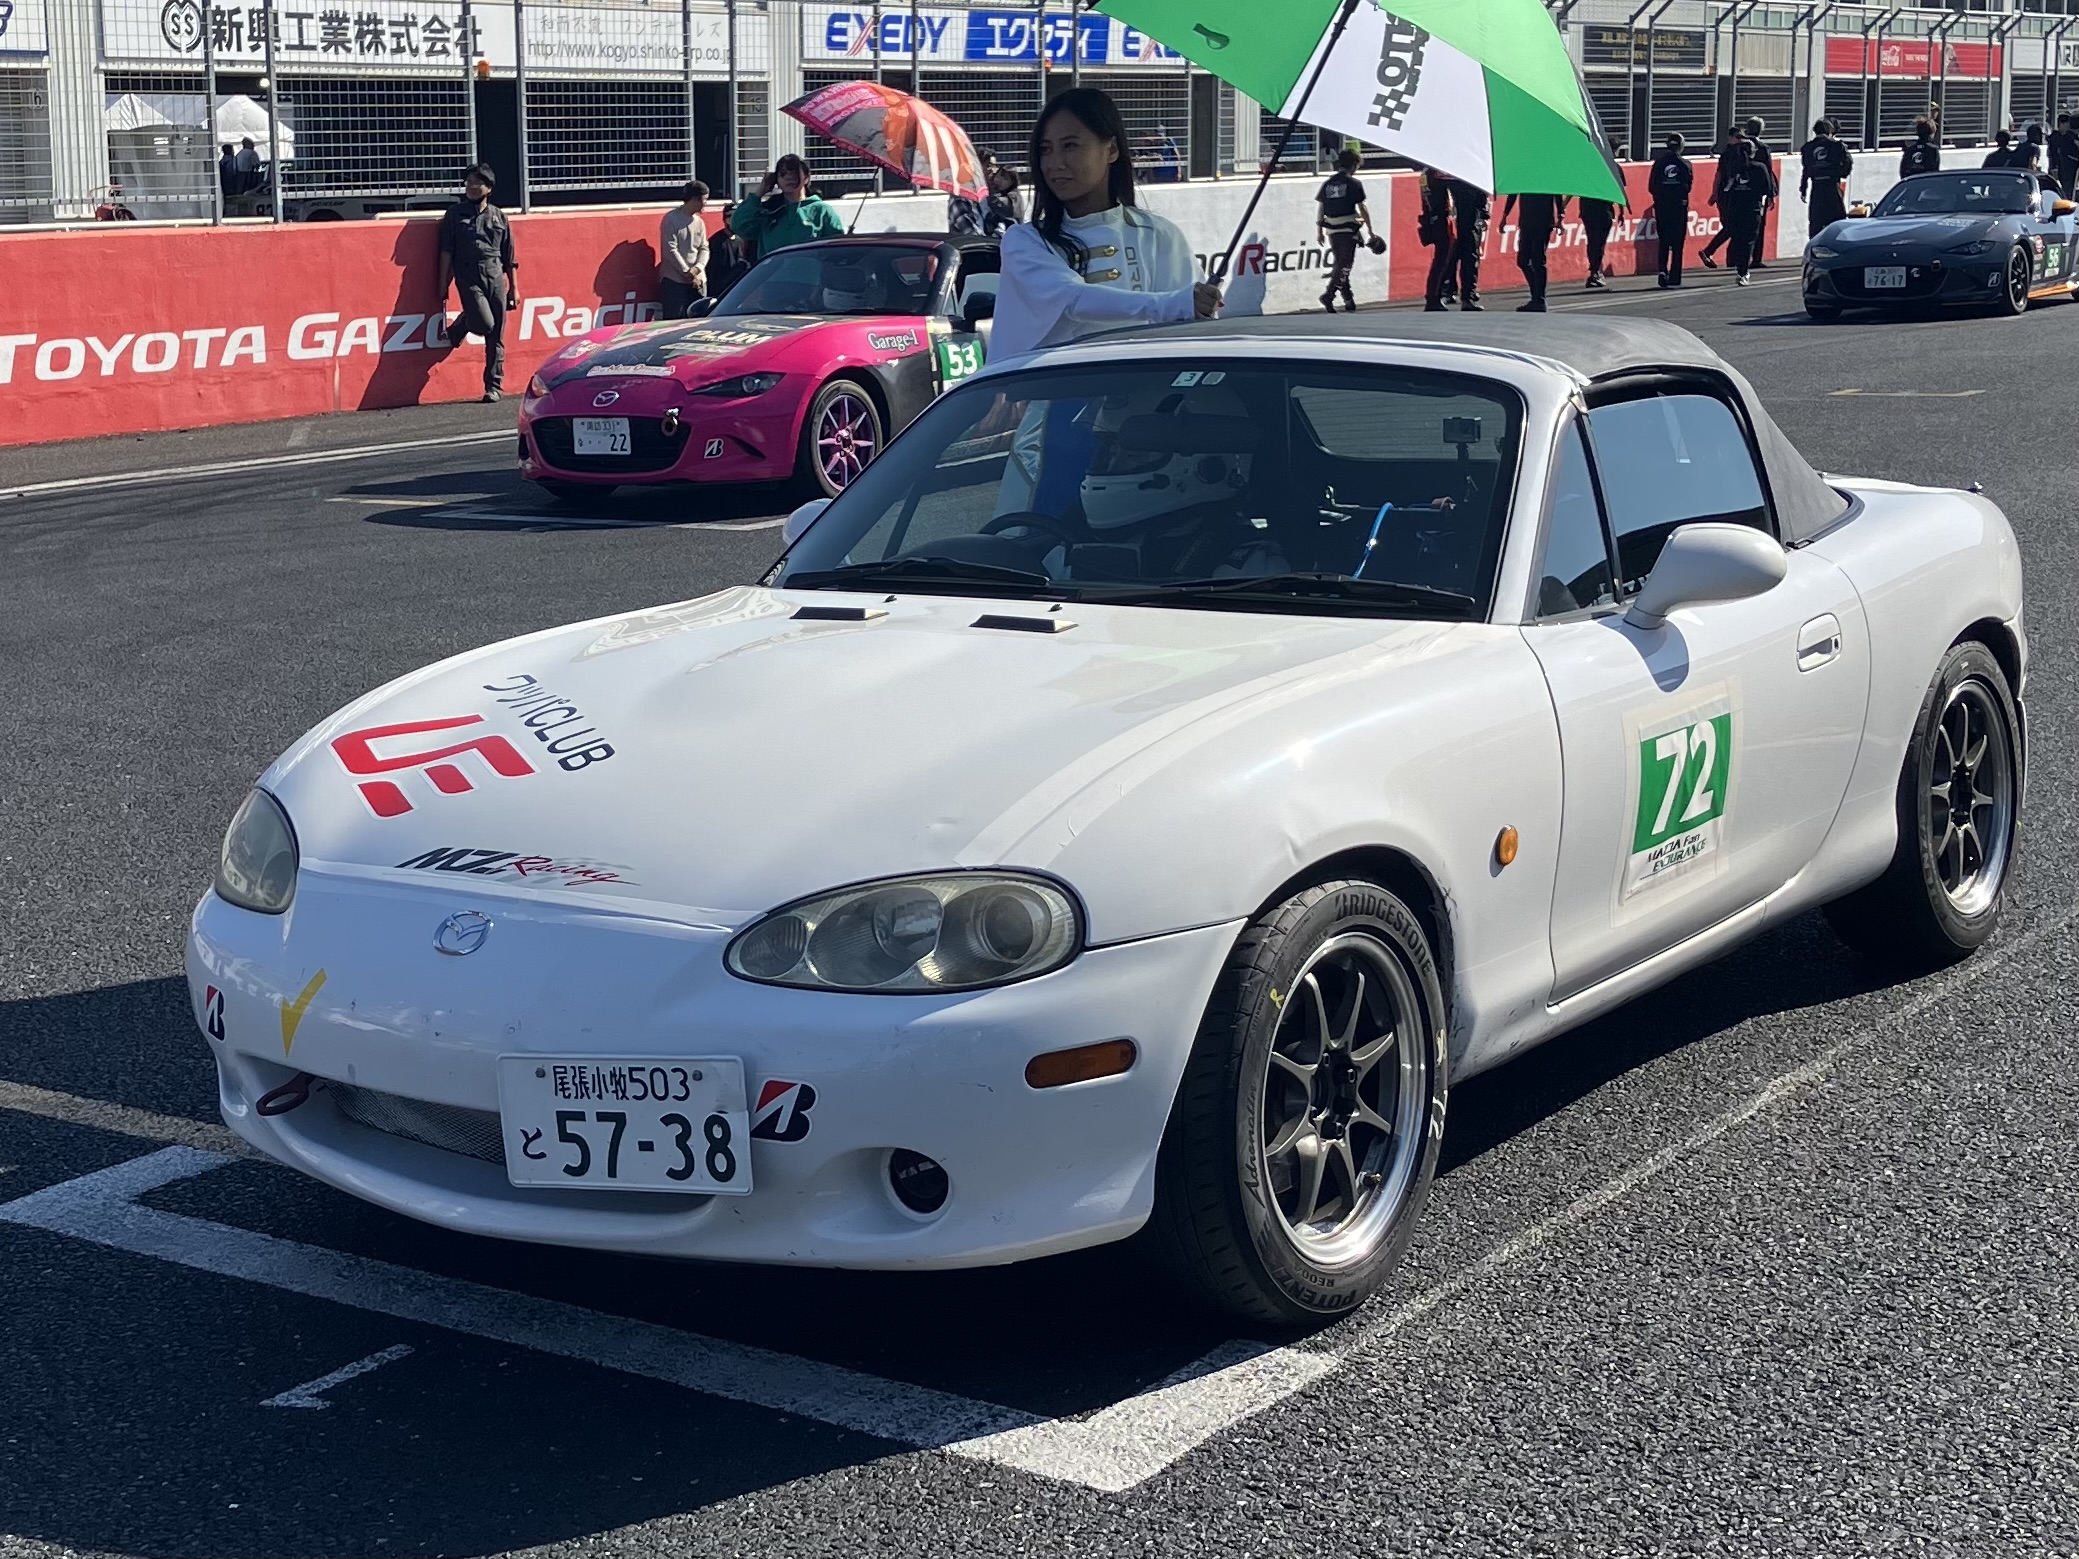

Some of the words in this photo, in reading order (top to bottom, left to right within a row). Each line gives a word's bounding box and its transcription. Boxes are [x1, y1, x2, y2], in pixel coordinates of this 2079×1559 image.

[826, 12, 951, 57] EXEDY
[986, 17, 1091, 58] エクセディ
[0, 325, 267, 384] TOYOTA
[946, 343, 979, 378] 53
[610, 433, 628, 452] 22
[1651, 720, 1717, 836] 72
[1334, 893, 1433, 978] BRIDGESTONE
[519, 1127, 547, 1160] と
[555, 1110, 737, 1183] 57-38
